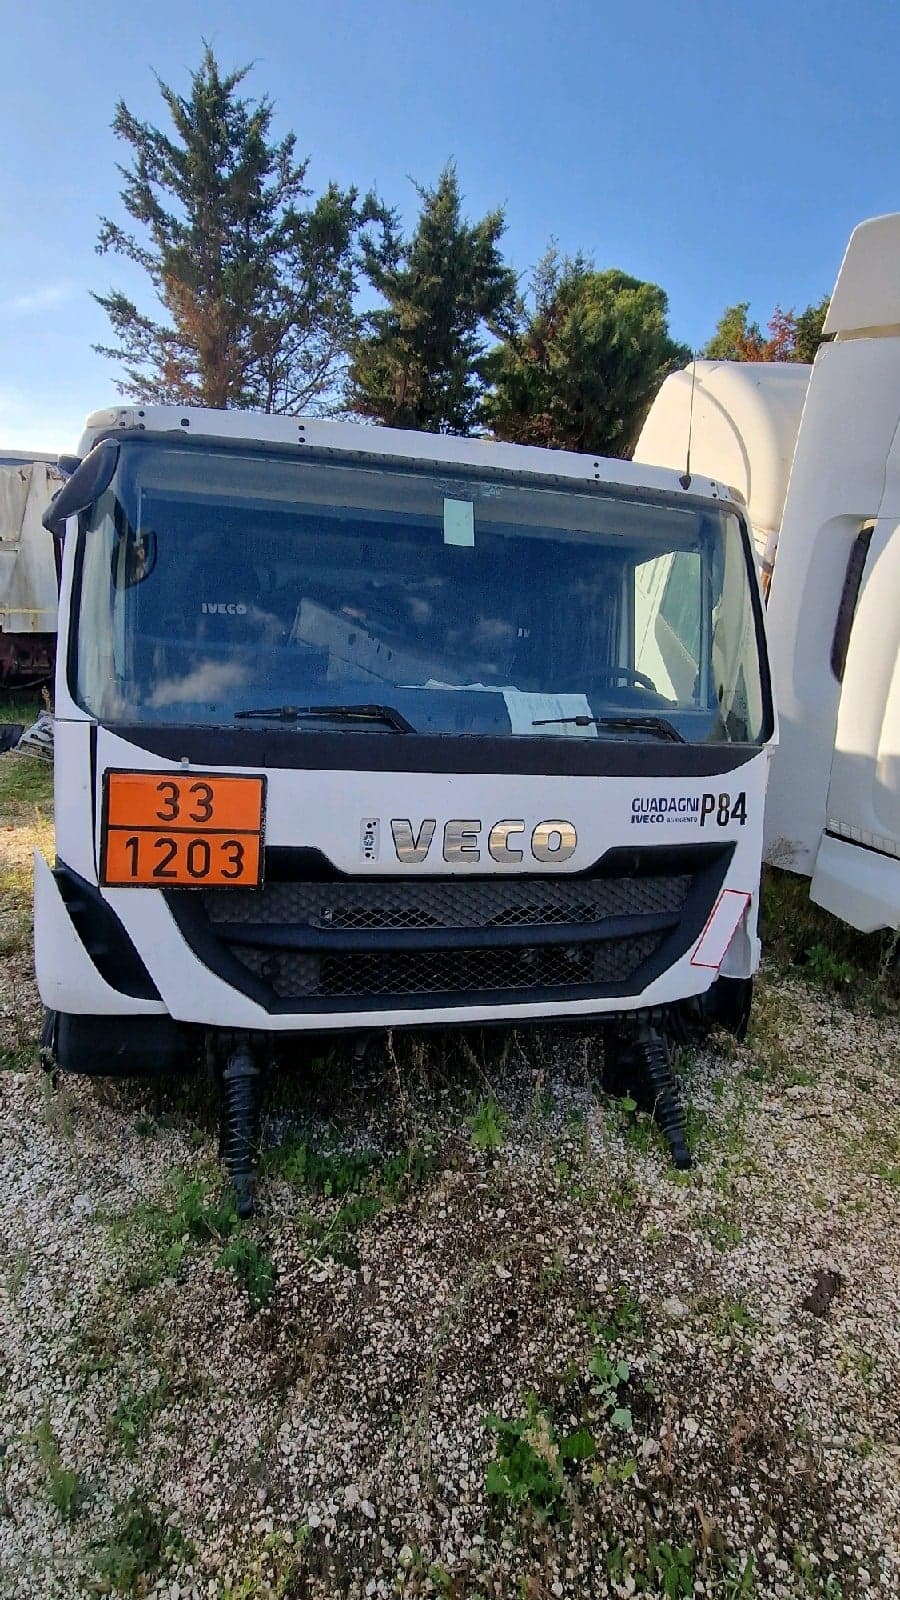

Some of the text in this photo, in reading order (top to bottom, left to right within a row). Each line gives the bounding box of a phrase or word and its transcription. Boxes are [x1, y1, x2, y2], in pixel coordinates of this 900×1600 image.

[201, 602, 247, 615] IVECO
[156, 781, 214, 823] 33
[631, 797, 699, 812] GUADAGNI
[700, 791, 747, 827] P84
[631, 814, 664, 824] IVECO
[125, 836, 245, 879] 1203
